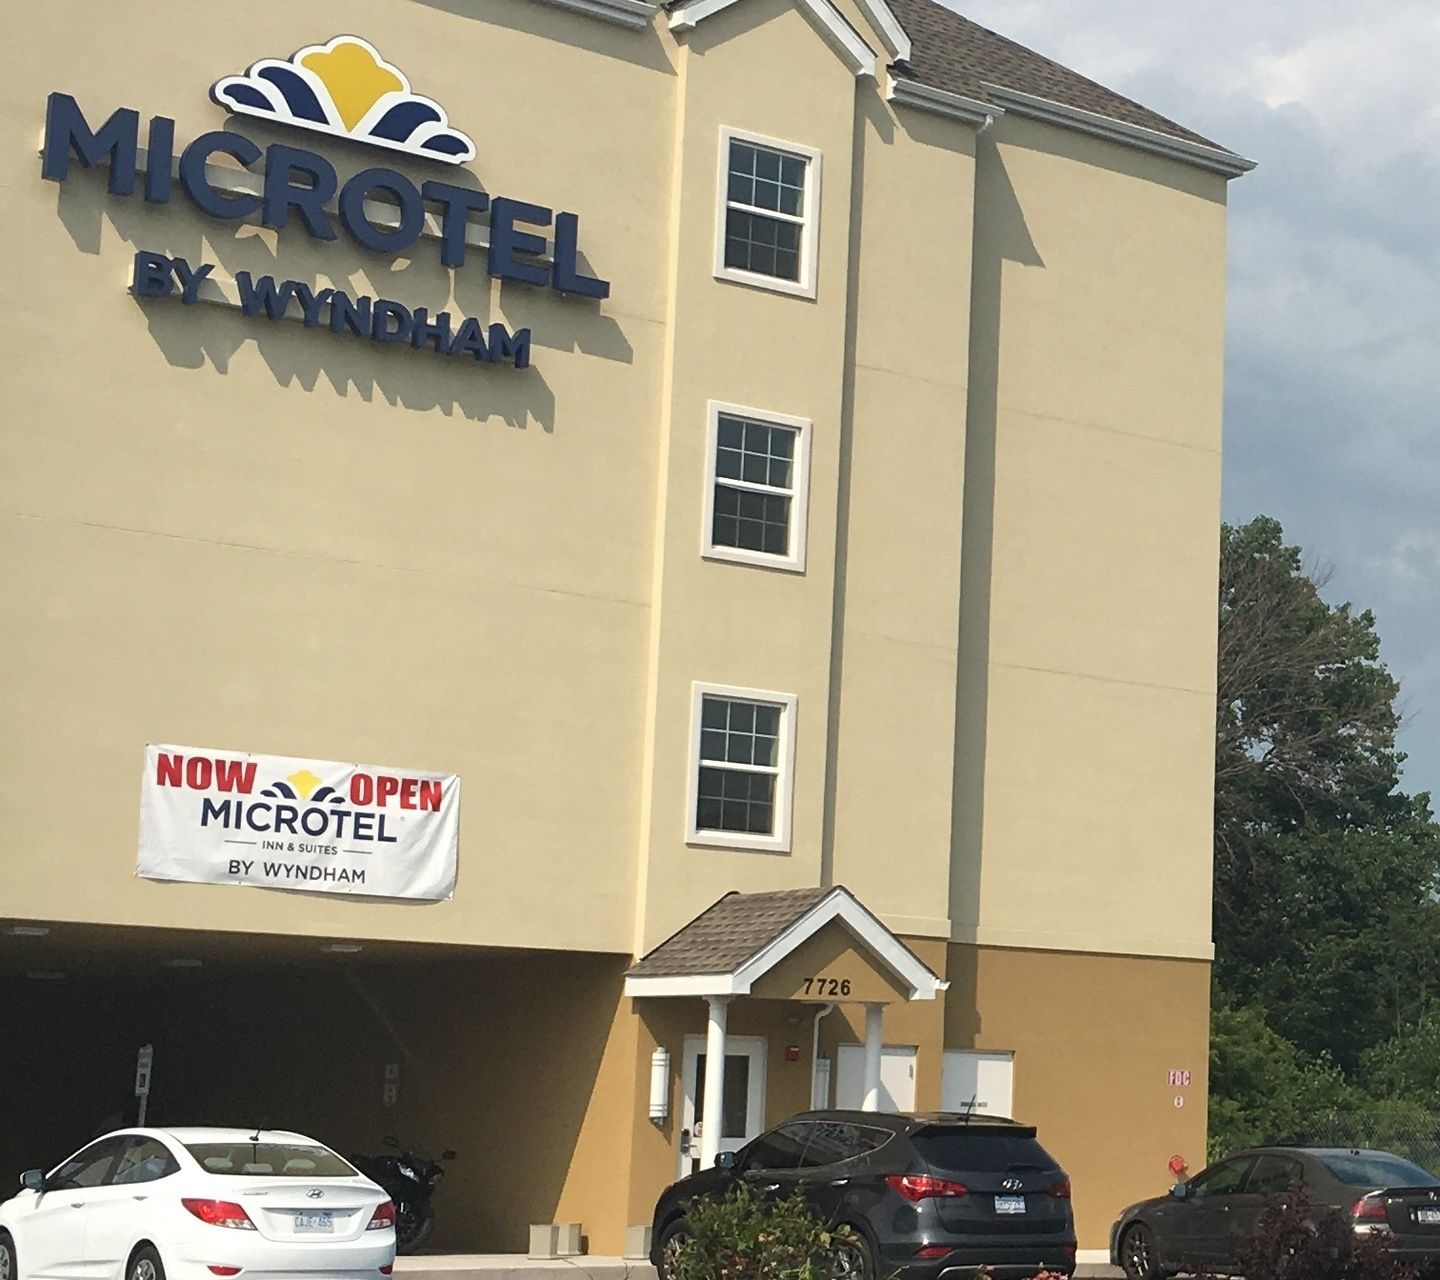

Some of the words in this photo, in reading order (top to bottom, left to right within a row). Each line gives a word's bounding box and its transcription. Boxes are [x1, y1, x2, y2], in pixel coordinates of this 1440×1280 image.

[41, 91, 610, 300] MICROTEL
[133, 250, 214, 304] BY
[236, 271, 531, 369] WYNDHAM
[156, 753, 257, 794] NOW
[350, 773, 442, 812] OPEN
[200, 798, 397, 843] MICROTEL
[262, 840, 284, 851] INN
[287, 843, 295, 852] &
[298, 843, 338, 855] SUITES
[228, 859, 254, 875] BY
[263, 862, 366, 884] WYNDHAM
[804, 977, 851, 996] 7726
